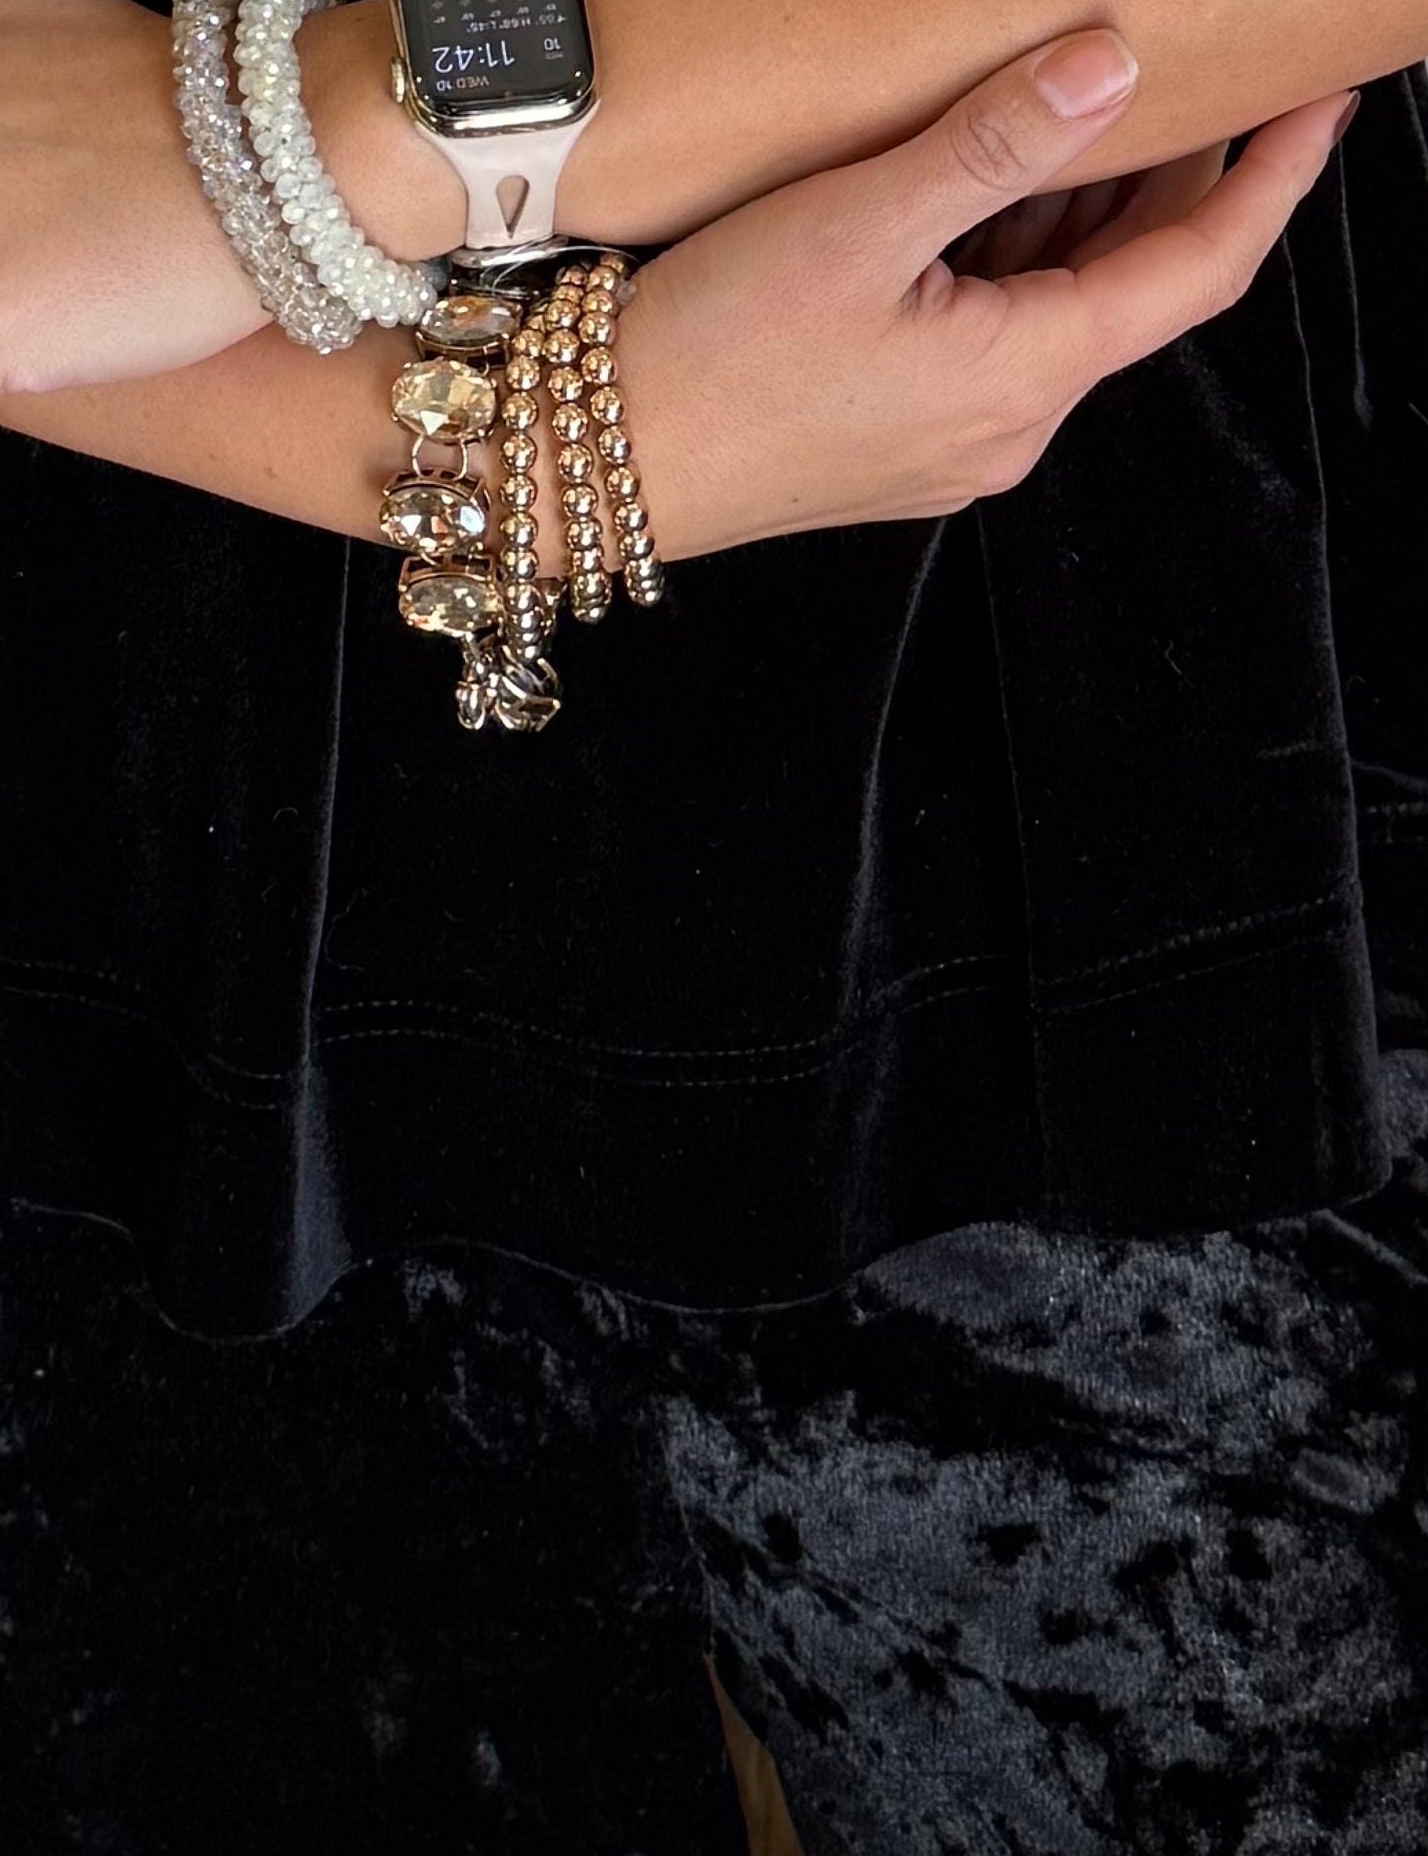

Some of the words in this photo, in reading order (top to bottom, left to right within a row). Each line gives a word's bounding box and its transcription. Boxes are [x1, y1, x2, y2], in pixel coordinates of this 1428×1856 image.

[543, 37, 561, 51] 10
[431, 39, 515, 73] 11:42
[435, 79, 453, 92] 10
[456, 75, 490, 89] WED
